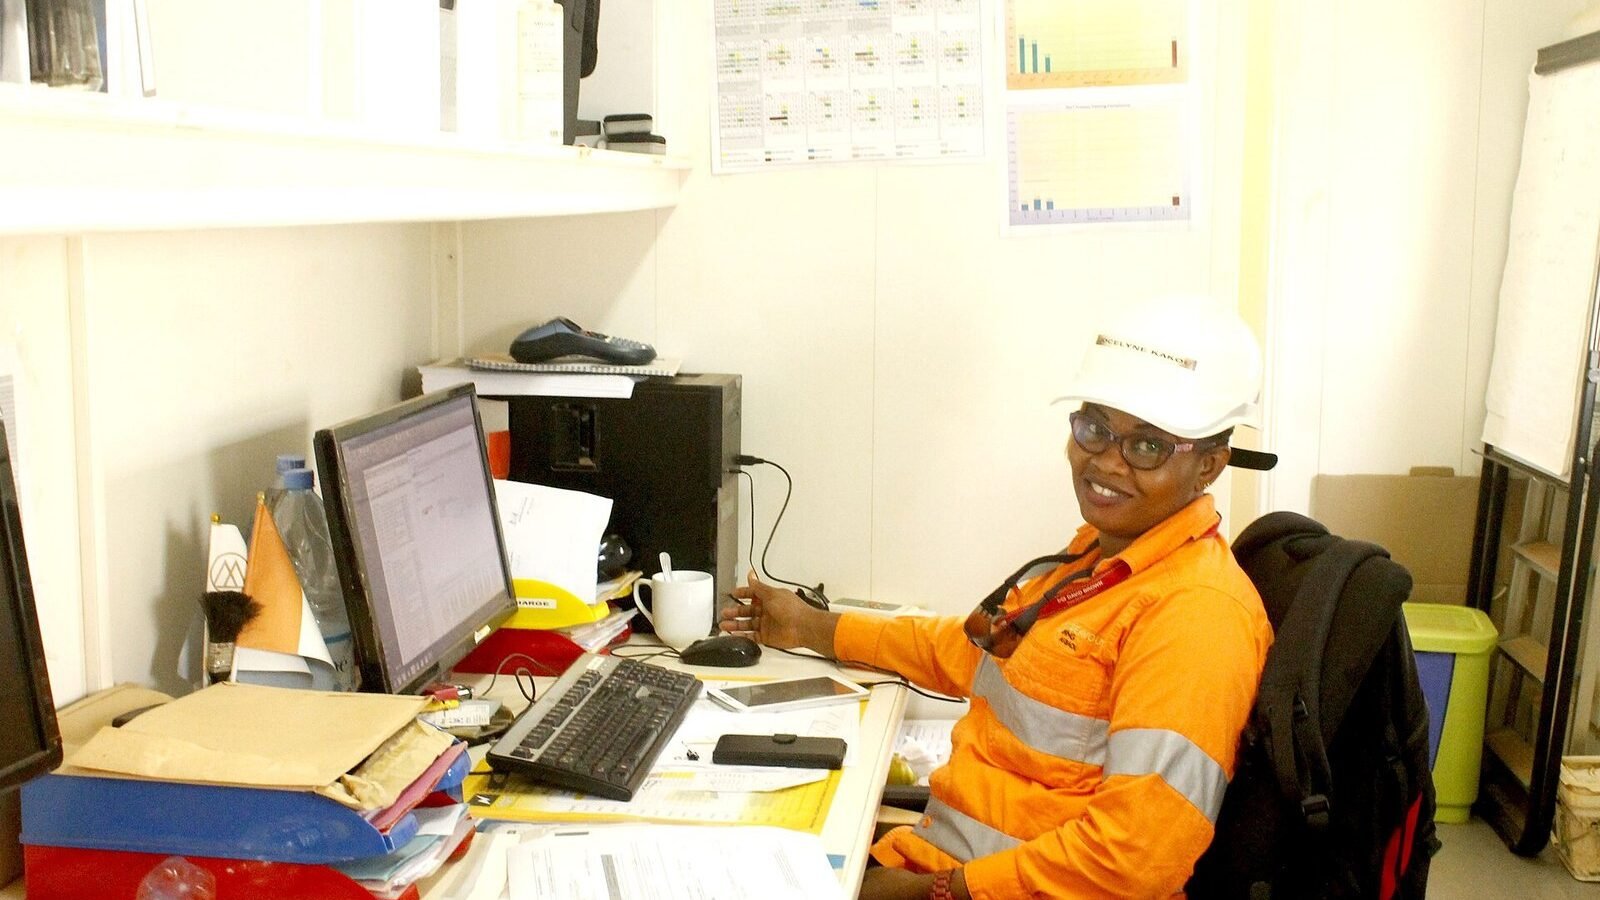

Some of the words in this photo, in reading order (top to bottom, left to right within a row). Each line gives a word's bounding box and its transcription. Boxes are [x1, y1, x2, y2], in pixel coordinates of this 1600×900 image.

[1100, 338, 1147, 353] OCELYNE
[1066, 590, 1083, 600] DAVID
[1082, 580, 1104, 594] BROWN
